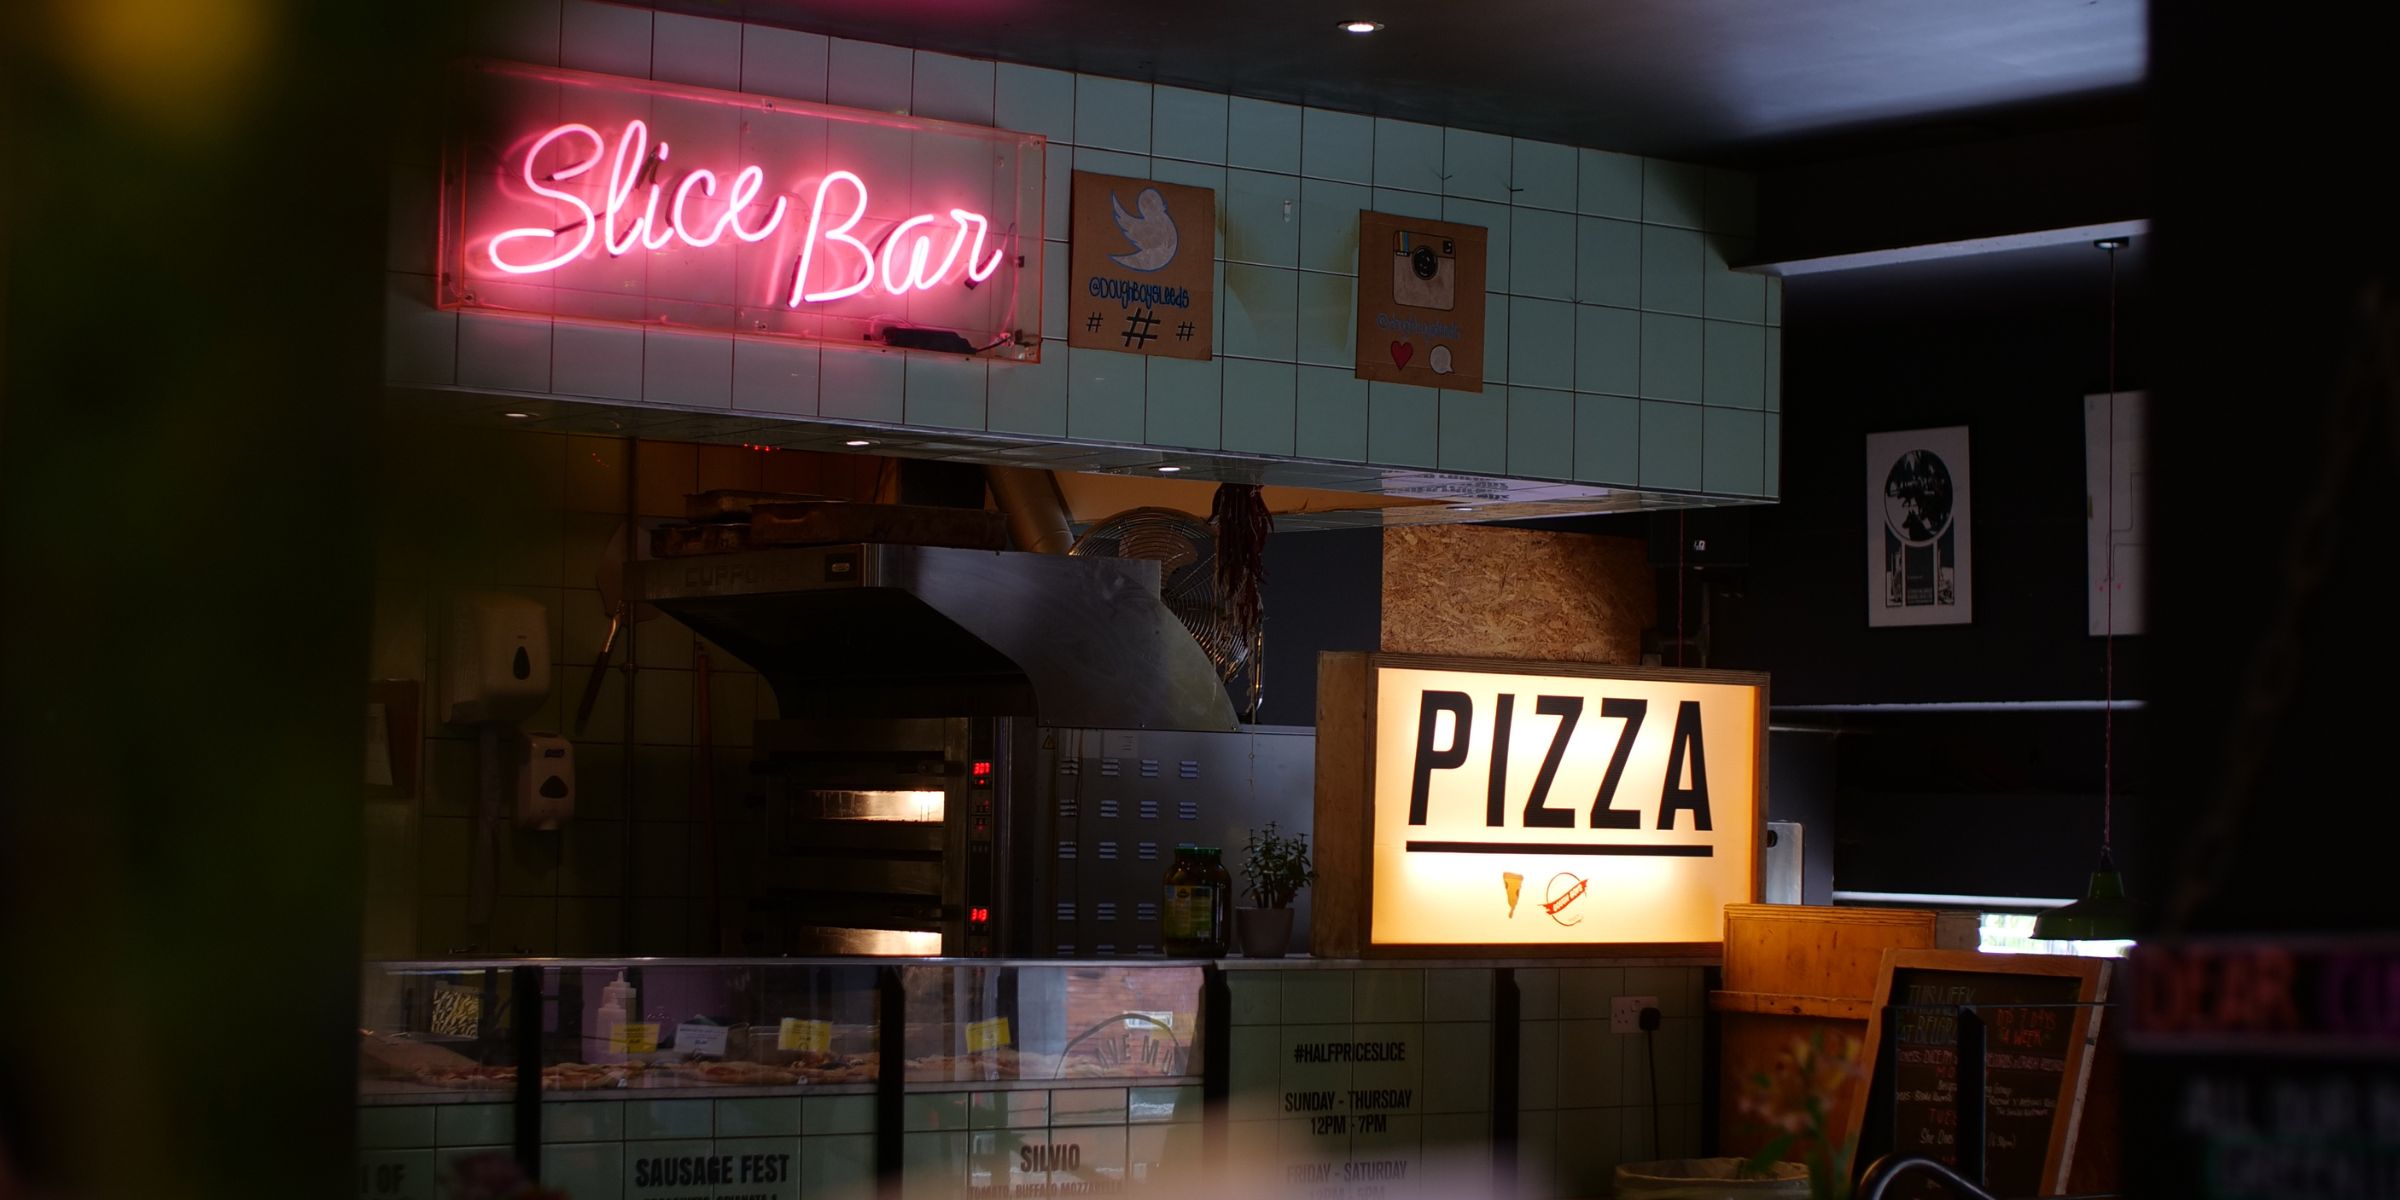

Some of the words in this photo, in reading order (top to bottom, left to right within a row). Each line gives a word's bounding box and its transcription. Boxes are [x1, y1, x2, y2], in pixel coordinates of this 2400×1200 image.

[489, 119, 788, 275] Slice
[788, 170, 1004, 308] Bar
[1408, 689, 1713, 831] PIZZA
[1294, 1042, 1406, 1063] #HALFPRICESLICE
[1285, 1092, 1335, 1112] SUNDAY
[1348, 1088, 1413, 1110] THURSDAY
[1311, 1116, 1347, 1135] 12PM
[1358, 1114, 1388, 1133] 7PM
[635, 1157, 733, 1187] SAUSAGE
[741, 1154, 790, 1183] FEST
[1020, 1143, 1081, 1172] SILVIO
[1287, 1163, 1332, 1184] FRIDAY
[1344, 1160, 1408, 1182] SATURDAY
